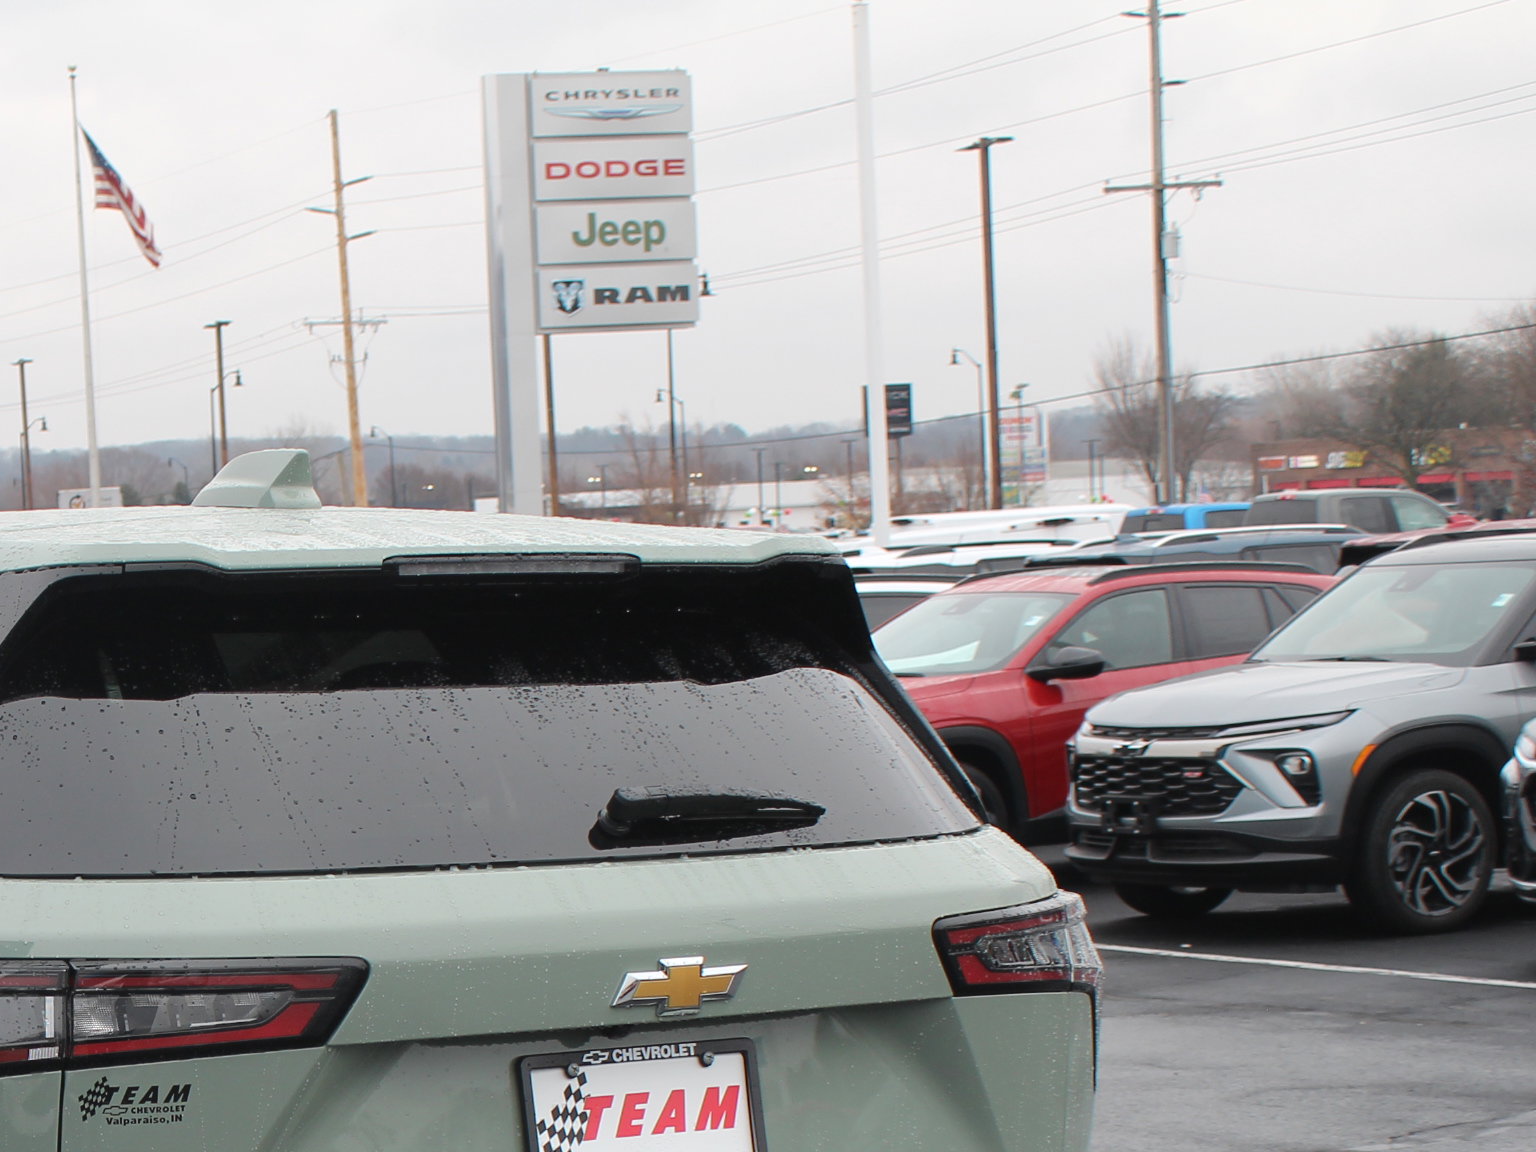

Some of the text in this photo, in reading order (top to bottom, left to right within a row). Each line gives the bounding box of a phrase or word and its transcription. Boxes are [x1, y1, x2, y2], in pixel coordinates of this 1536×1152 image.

[544, 88, 680, 102] CHRYSLER
[544, 159, 686, 180] DODGE
[572, 212, 667, 252] Jeep
[593, 285, 691, 305] RAM
[612, 1043, 697, 1063] CHEVROLET
[103, 1084, 192, 1105] TEAM
[130, 1105, 186, 1115] CHEVROLET
[582, 1085, 741, 1142] TEAM
